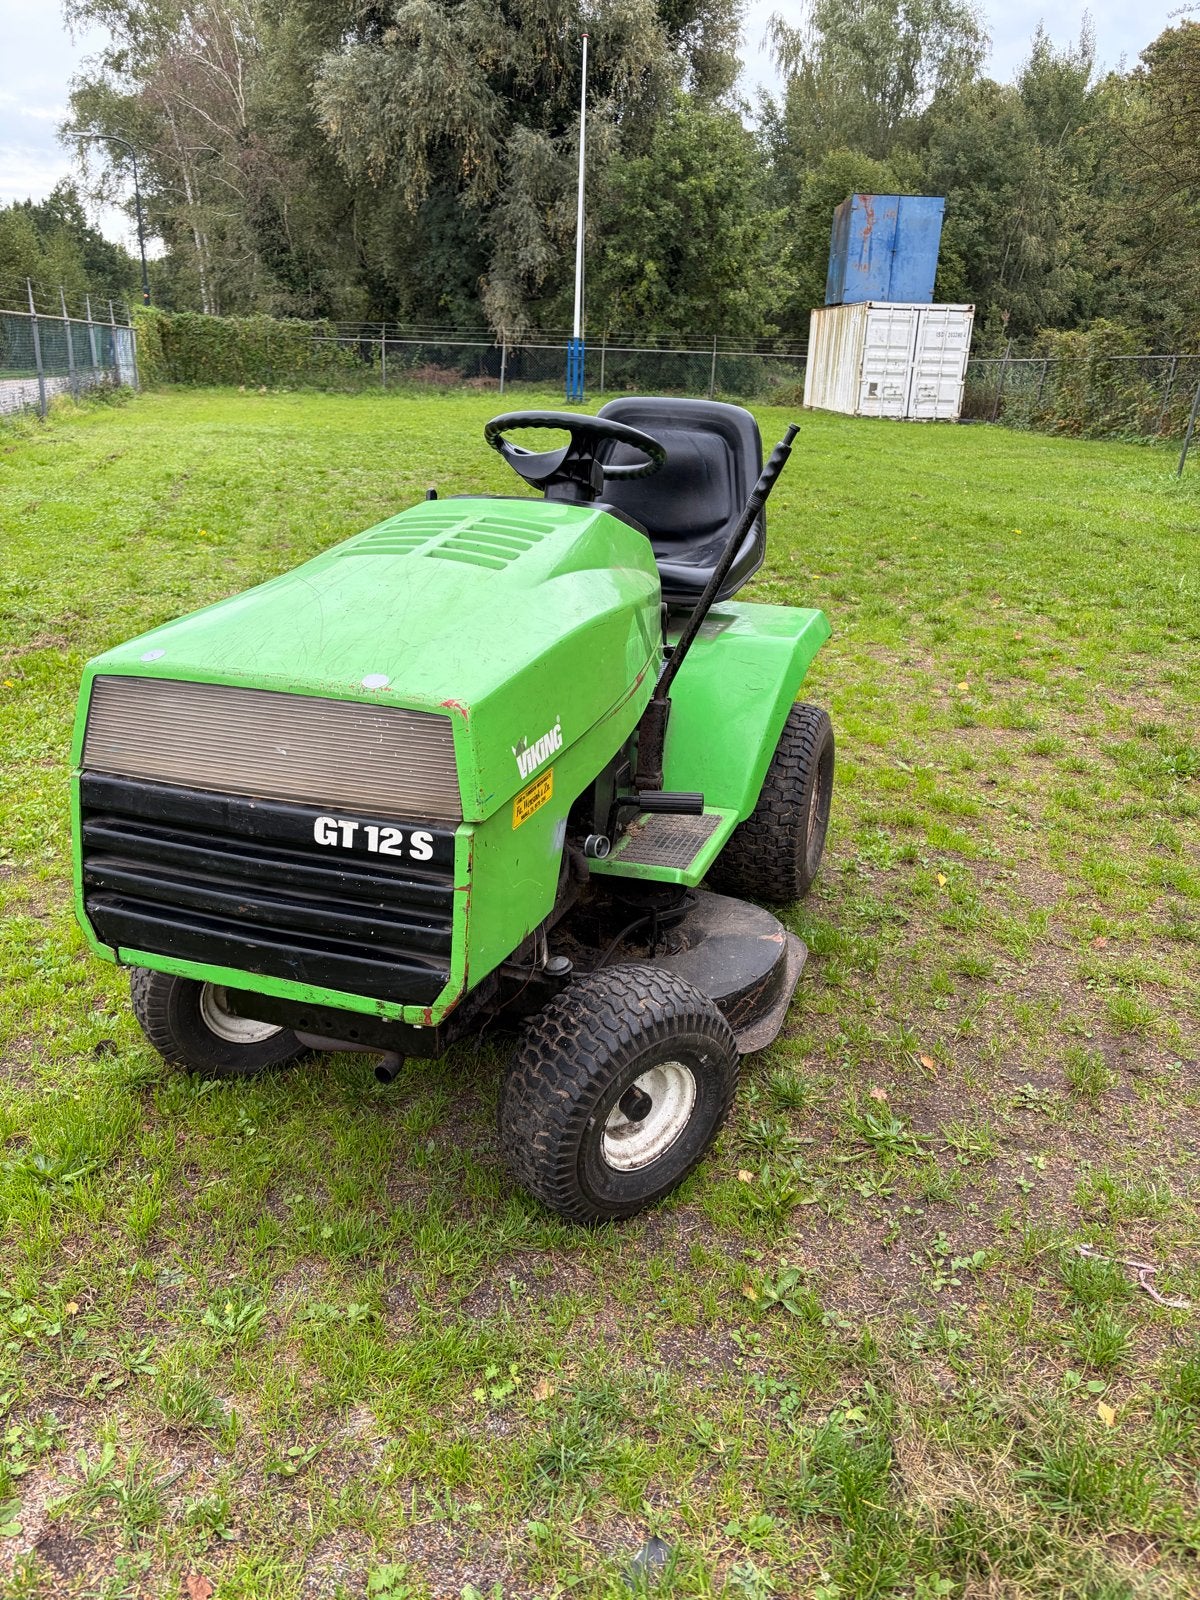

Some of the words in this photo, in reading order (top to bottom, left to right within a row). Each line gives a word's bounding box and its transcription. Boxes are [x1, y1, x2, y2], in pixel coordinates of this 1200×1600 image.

[313, 816, 359, 849] GT
[363, 825, 403, 856] 12
[409, 831, 434, 861] S
